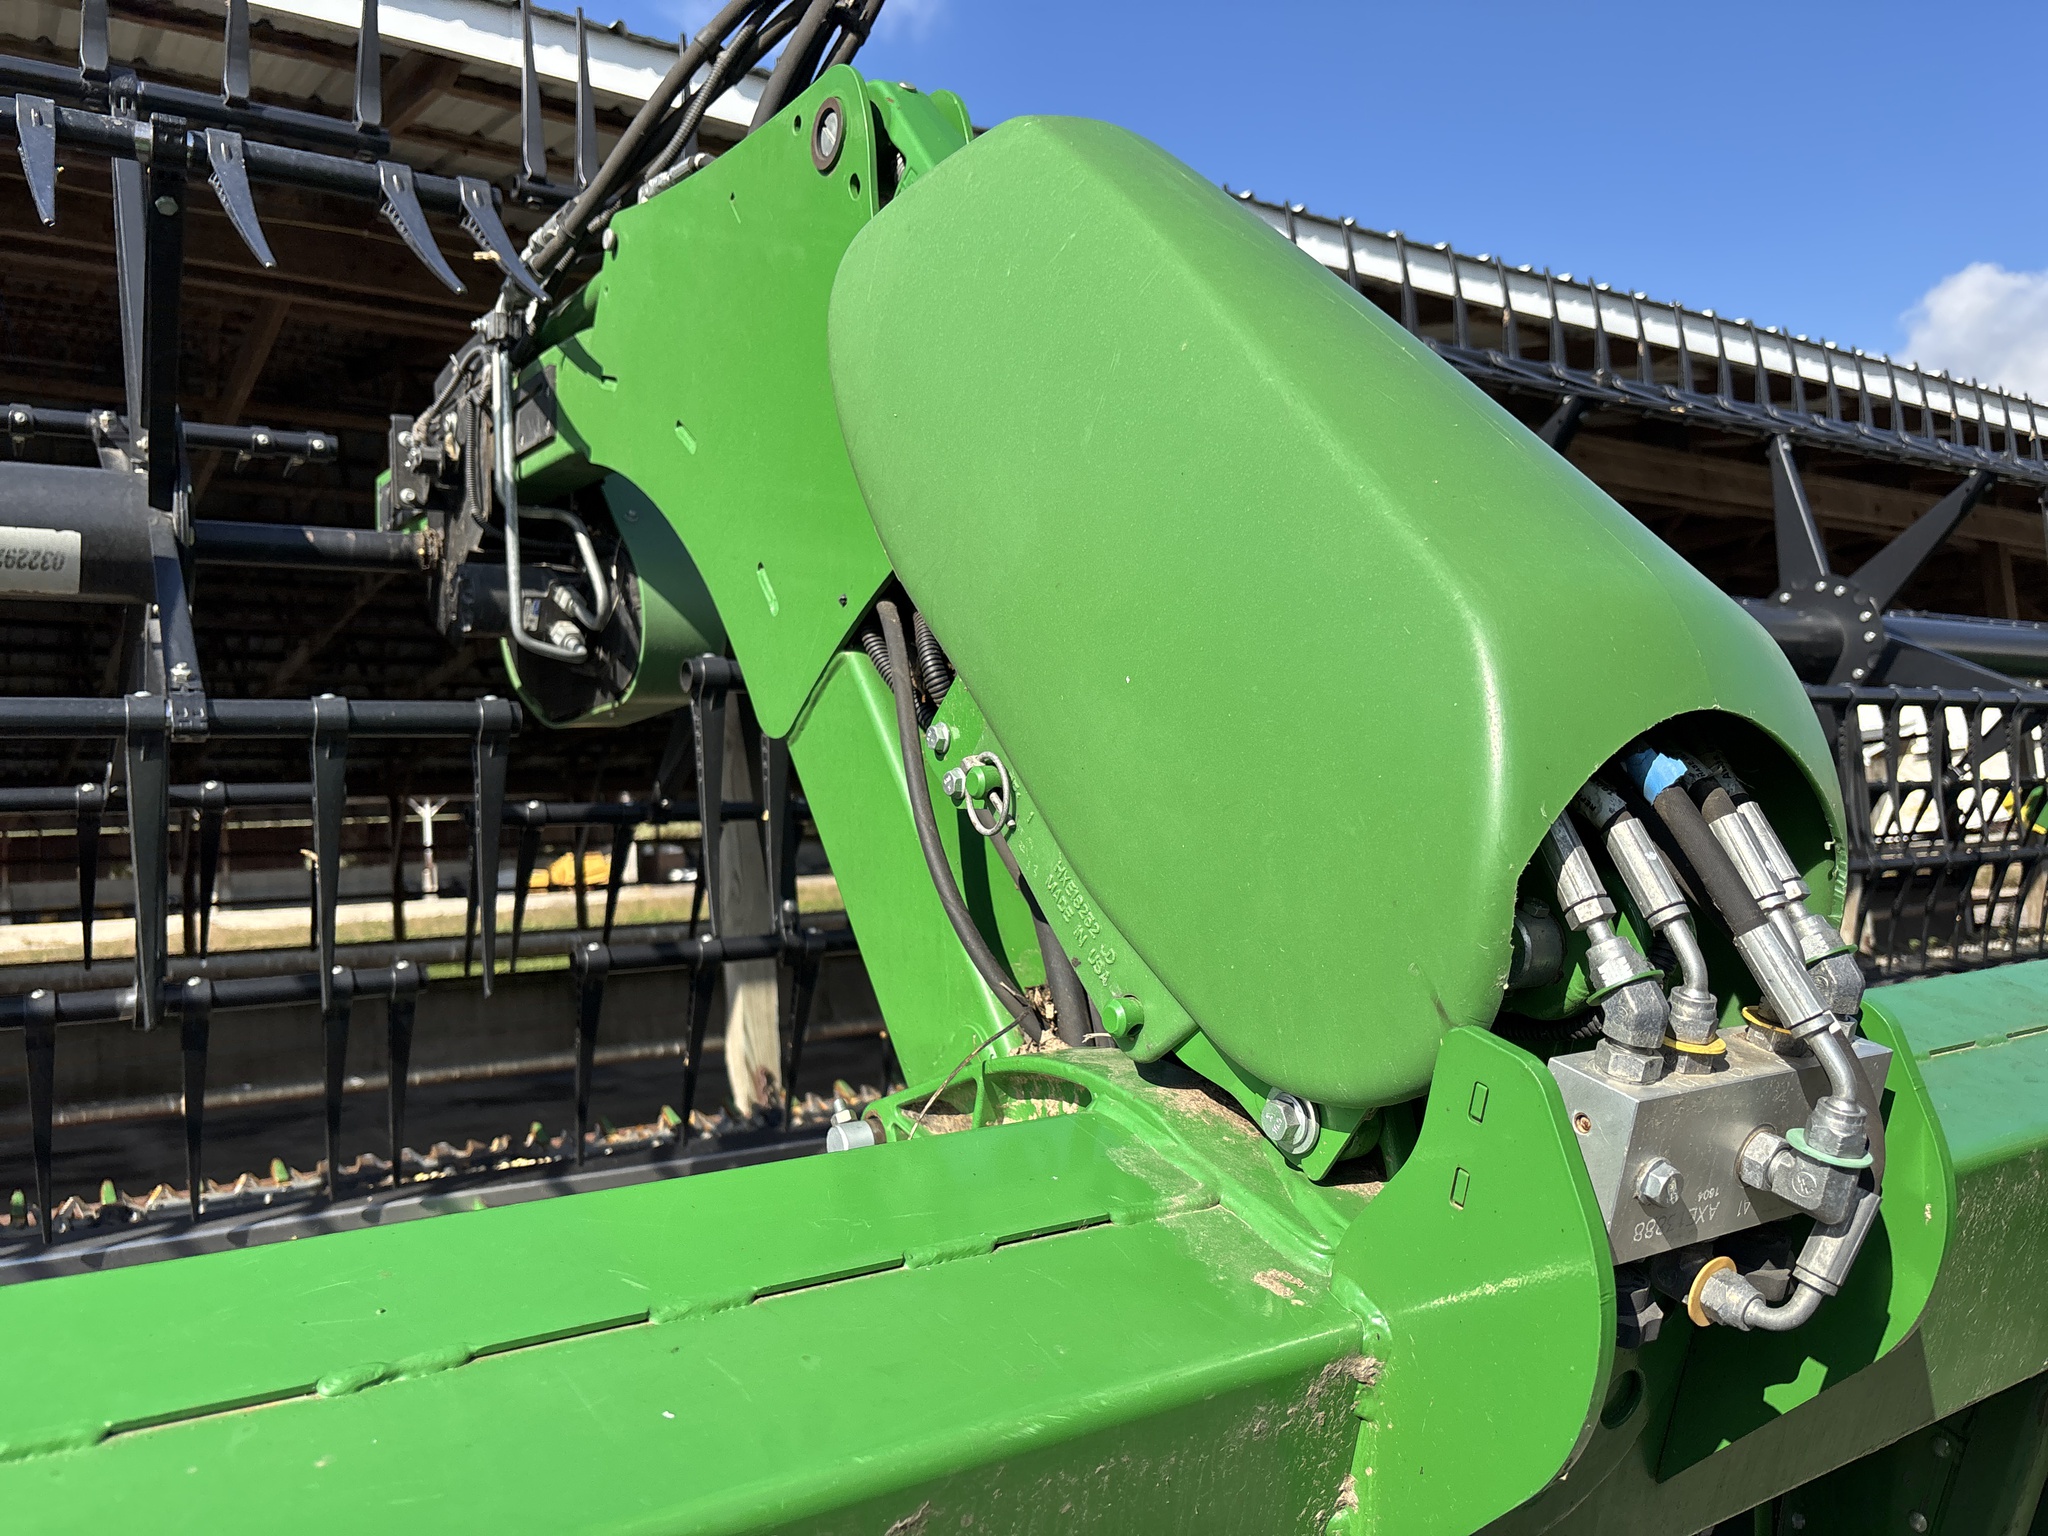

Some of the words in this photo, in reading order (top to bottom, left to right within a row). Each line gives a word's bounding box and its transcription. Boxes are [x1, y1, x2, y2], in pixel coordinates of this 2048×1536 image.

[1045, 874, 1075, 924] MADE
[1073, 925, 1089, 948] IN
[1087, 948, 1111, 988] USA
